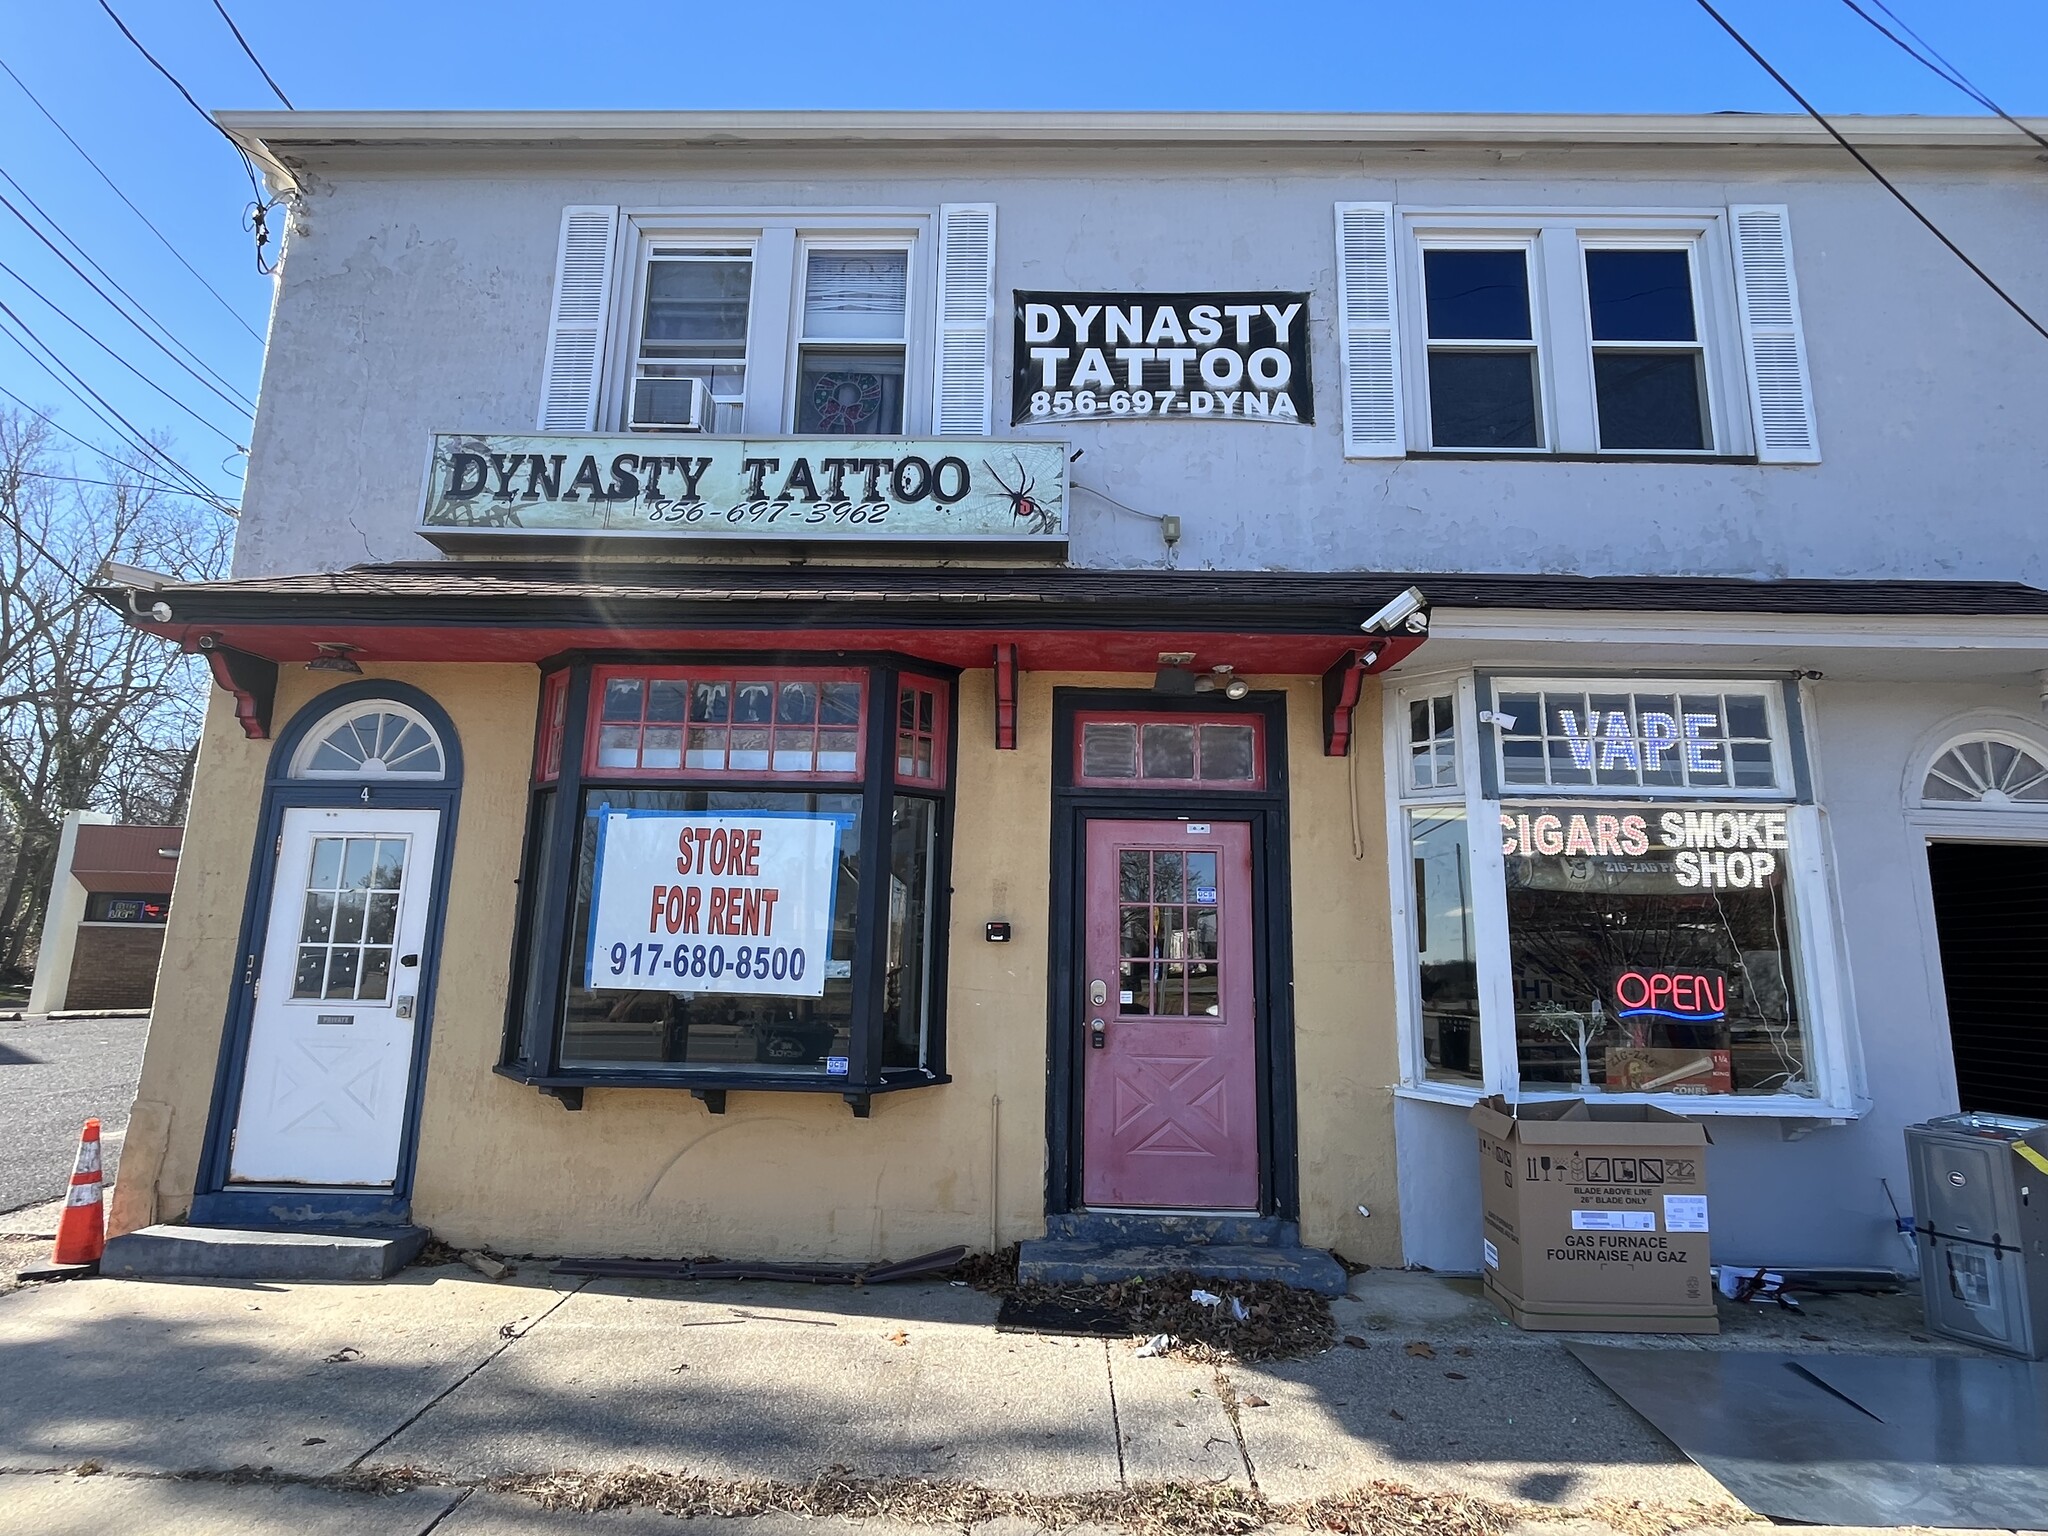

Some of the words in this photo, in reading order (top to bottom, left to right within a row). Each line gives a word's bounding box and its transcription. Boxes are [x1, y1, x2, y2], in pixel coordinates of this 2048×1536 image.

[1025, 303, 1302, 343] DYNASTY
[1030, 347, 1292, 388] TATTOO
[1029, 391, 1299, 416] 856-697-DYNA
[445, 454, 712, 503] DYNASTY
[745, 456, 970, 503] TATTOO
[648, 499, 888, 525] 856-697-3962
[1558, 709, 1722, 773] VAPE
[360, 787, 369, 802] 4
[1499, 814, 1650, 857] CIGARS
[1660, 811, 1790, 850] SMOKE
[677, 826, 761, 876] STORE
[1604, 862, 1658, 873] ZIG-ZAG
[1674, 851, 1776, 888] SHOP
[650, 885, 701, 934] FOR
[707, 887, 779, 936] RENT
[610, 942, 806, 981] 917-680-8500
[1616, 972, 1725, 1012] OPEN
[1609, 1050, 1658, 1068] ZIG-ZAG
[1672, 1086, 1709, 1095] CONES
[1574, 1187, 1602, 1195] BLADE
[1603, 1187, 1632, 1195] ABOVE
[1634, 1188, 1653, 1196] LINE
[1580, 1196, 1594, 1204] 26"
[1625, 1197, 1648, 1205] ONLY
[1547, 1249, 1629, 1262] FOURNAISE
[1633, 1250, 1653, 1262] AU
[1657, 1251, 1687, 1263] GAZ
[1565, 1236, 1595, 1247] GAS
[1599, 1236, 1668, 1249] FURNACE
